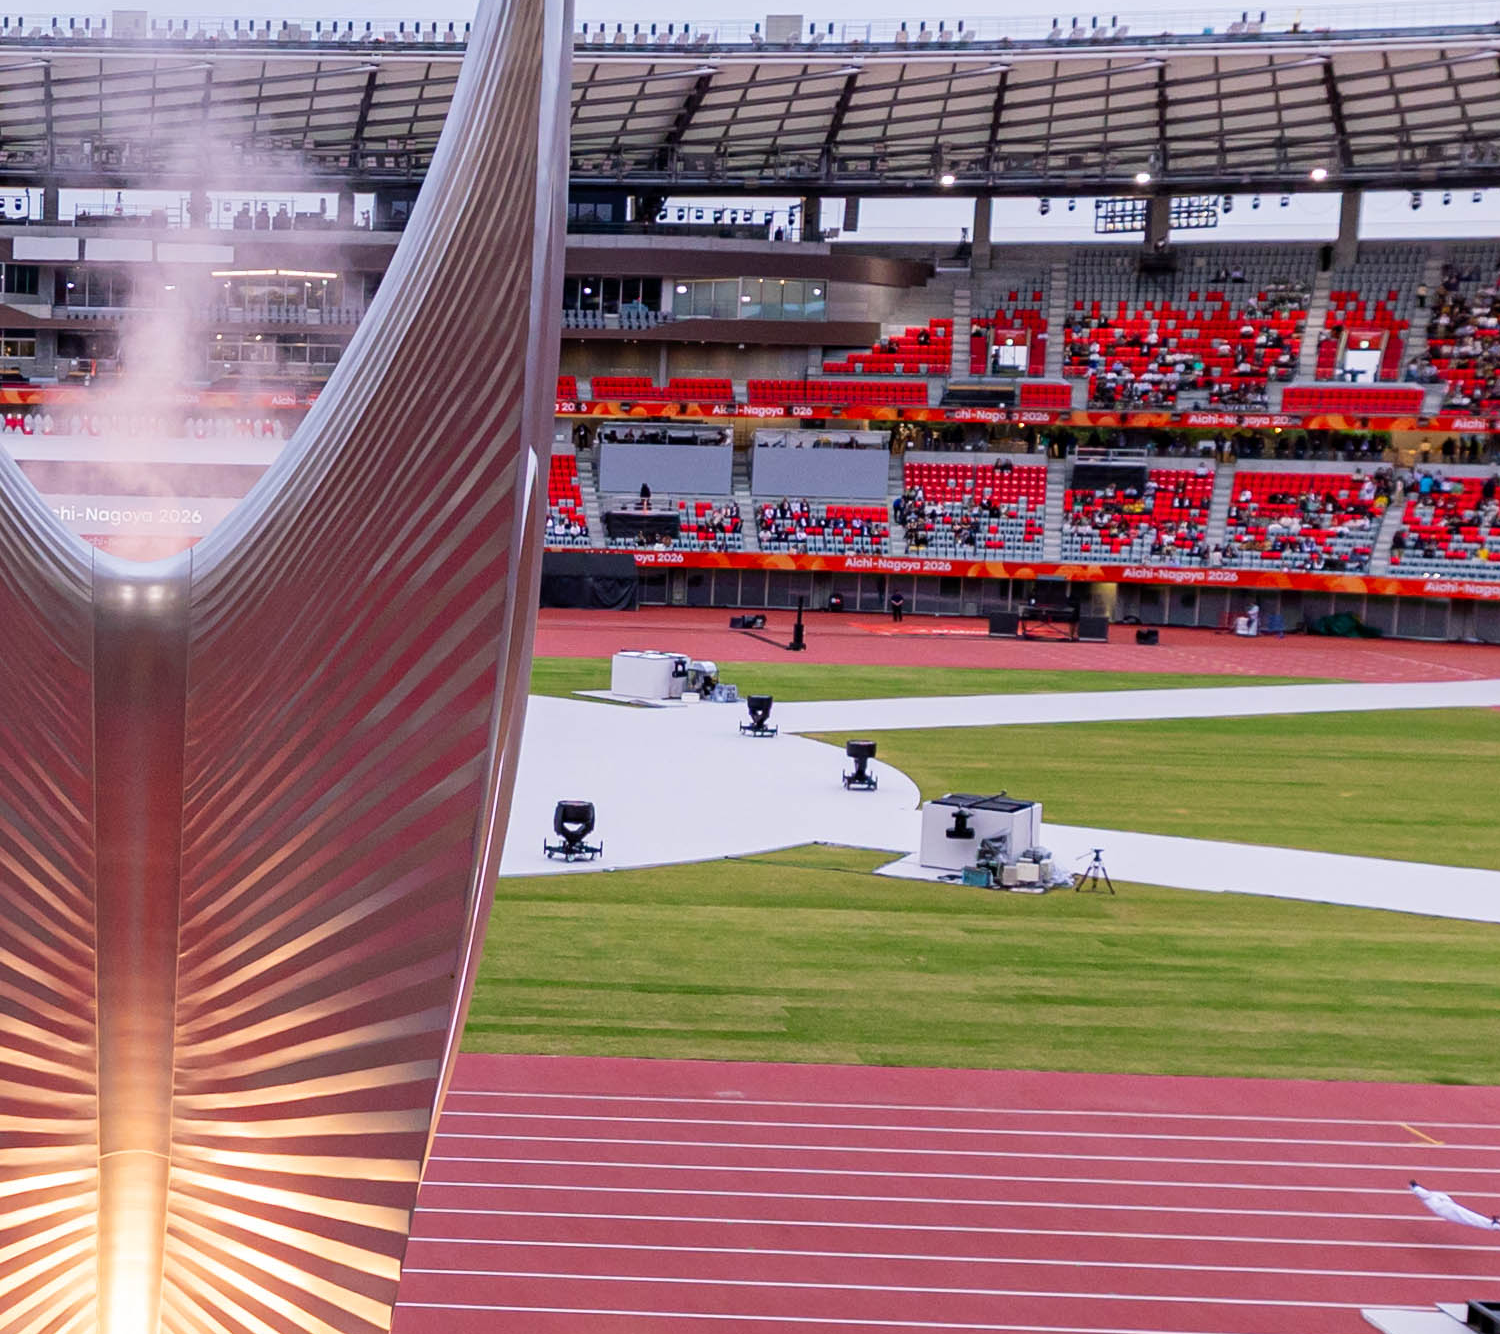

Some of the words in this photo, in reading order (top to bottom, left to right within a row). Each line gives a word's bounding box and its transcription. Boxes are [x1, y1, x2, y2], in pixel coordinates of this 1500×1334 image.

[561, 403, 587, 411] 206
[1022, 412, 1049, 421] 2026
[159, 509, 203, 524] 2026
[657, 553, 684, 563] 2026
[845, 558, 920, 571] Aichi-Nagoya
[923, 561, 951, 571] 2026
[1123, 569, 1205, 582] Aichi-Nagoya
[1208, 571, 1239, 582] 2026
